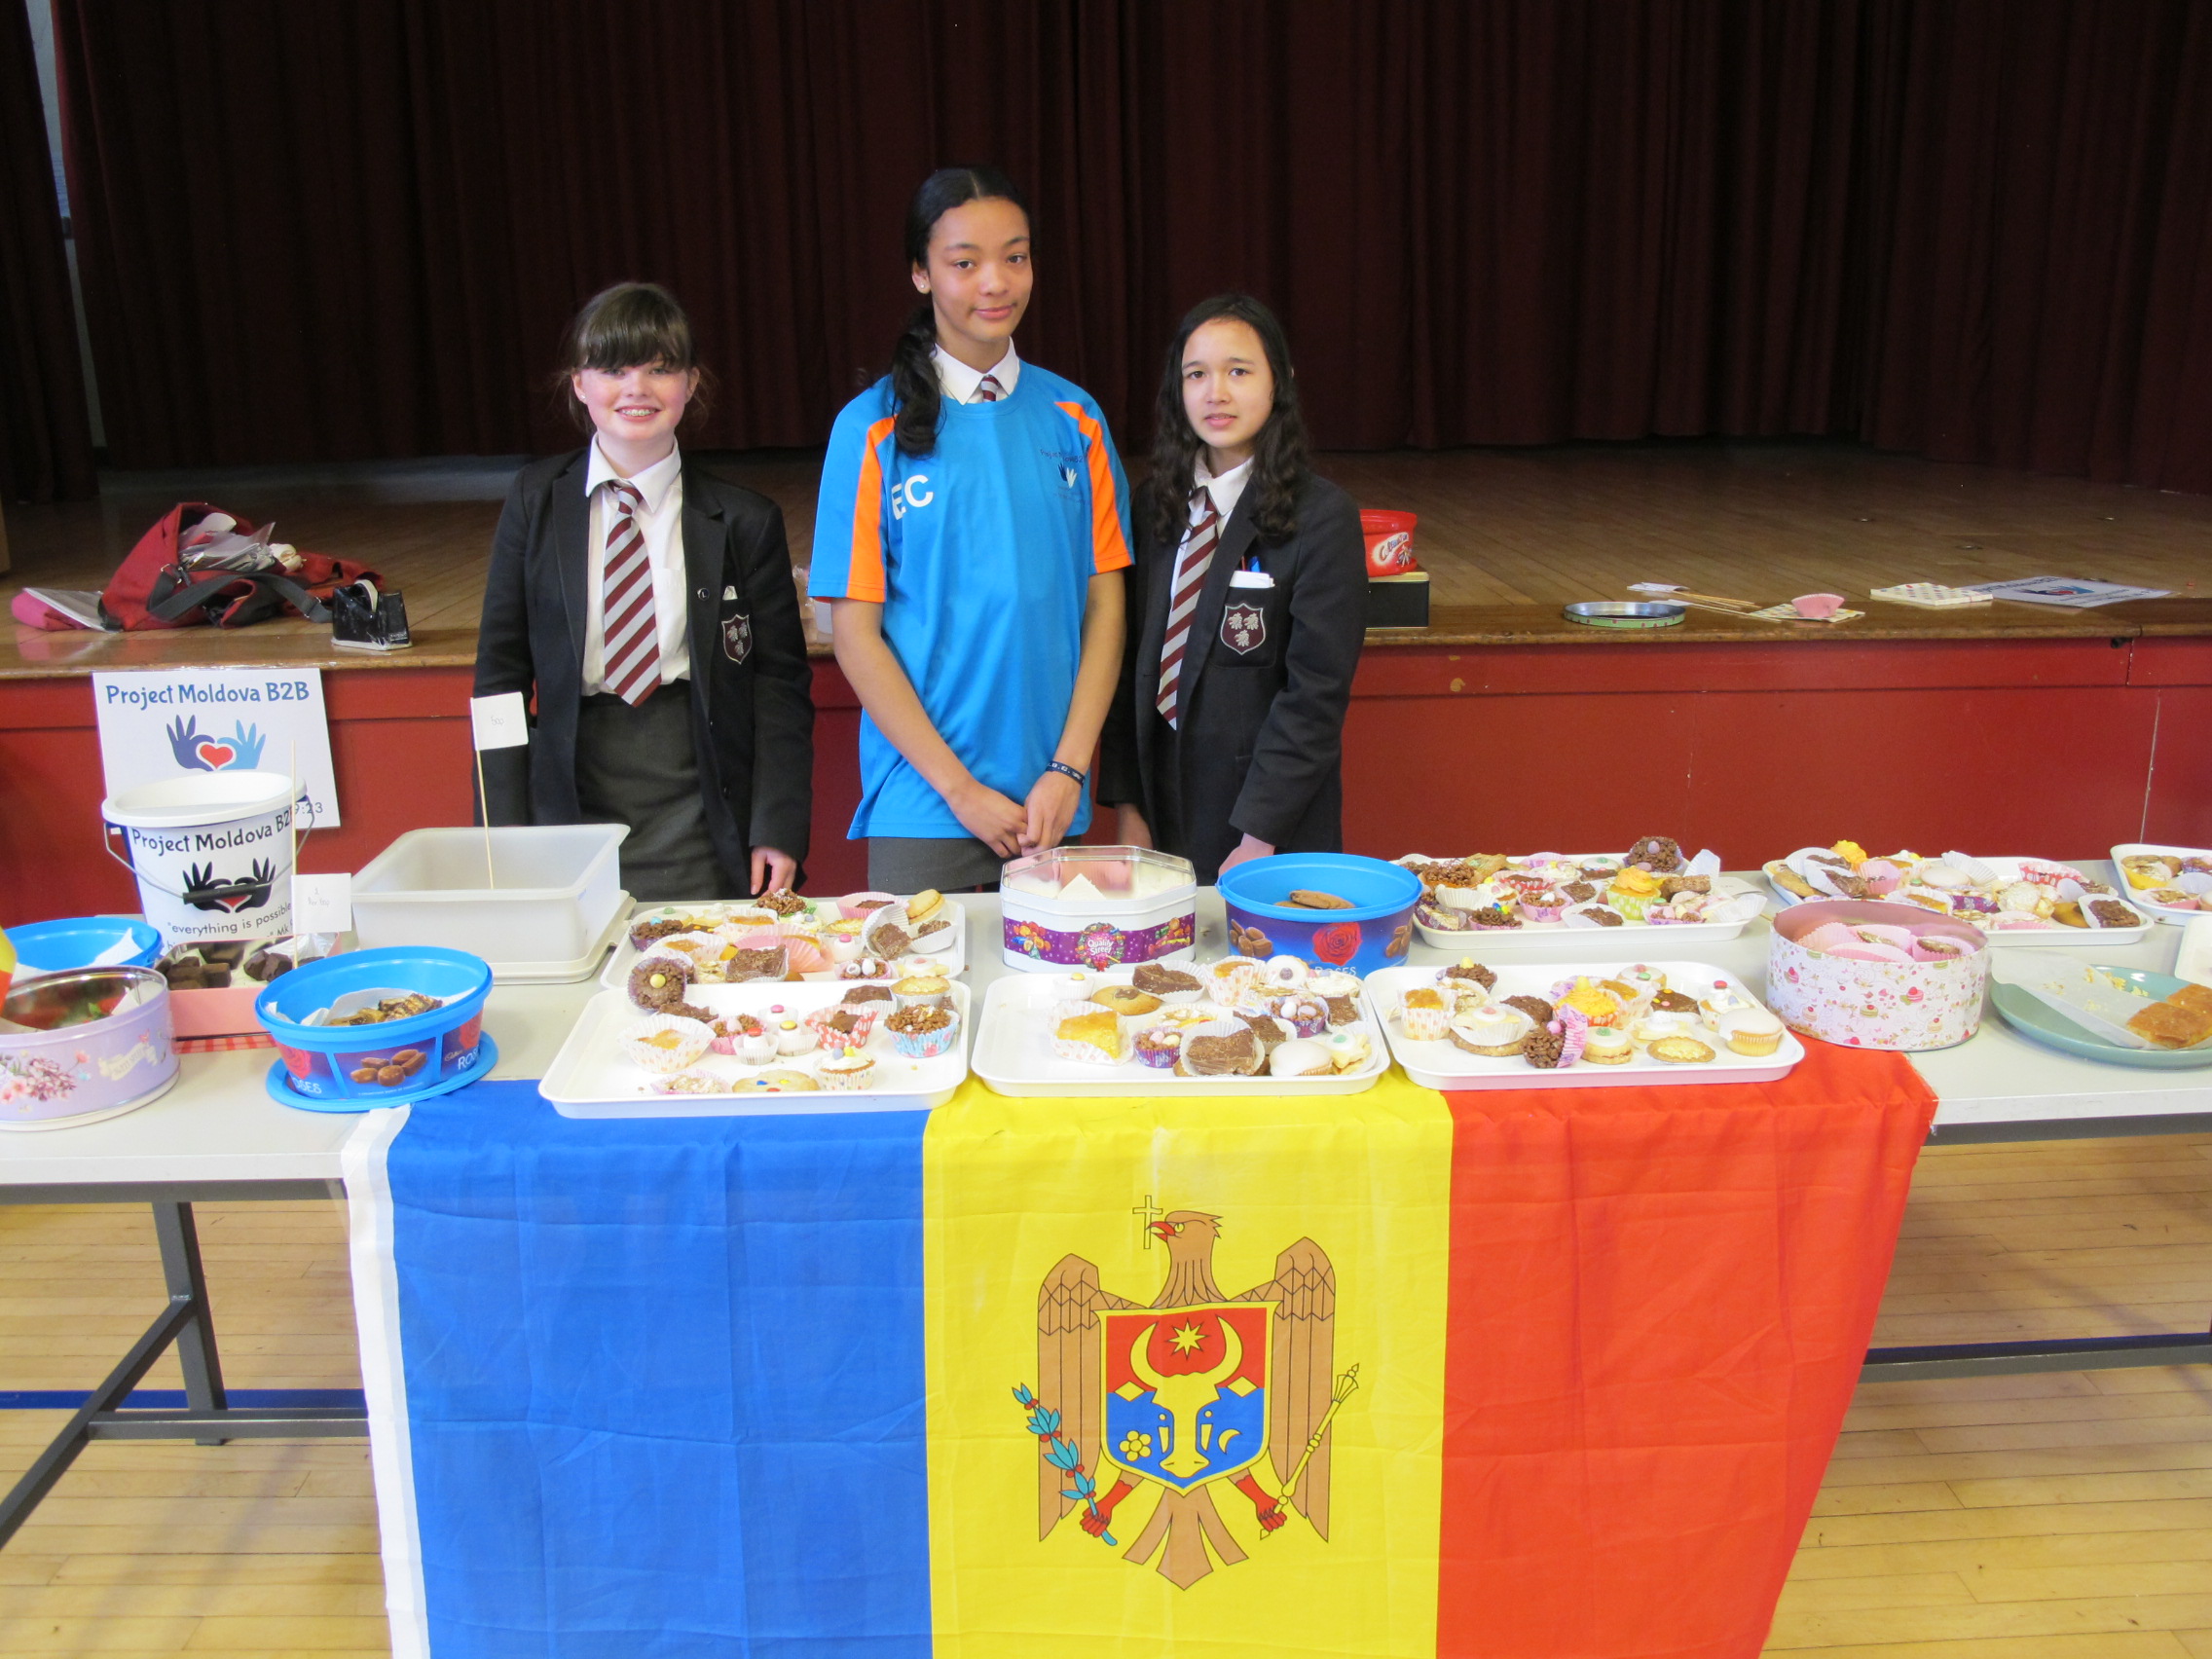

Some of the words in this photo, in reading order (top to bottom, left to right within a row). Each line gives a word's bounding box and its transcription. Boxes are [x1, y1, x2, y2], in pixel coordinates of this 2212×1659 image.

[891, 474, 935, 521] EC
[105, 684, 173, 711] Project
[177, 683, 261, 703] Moldova
[265, 682, 310, 702] B2B
[131, 828, 191, 857] Project
[195, 825, 273, 852] Moldova
[276, 805, 292, 833] B2
[242, 919, 251, 929] is
[255, 903, 292, 927] possible
[1088, 939, 1115, 948] Quality
[1089, 945, 1113, 956] Street
[291, 1076, 322, 1094] OSES
